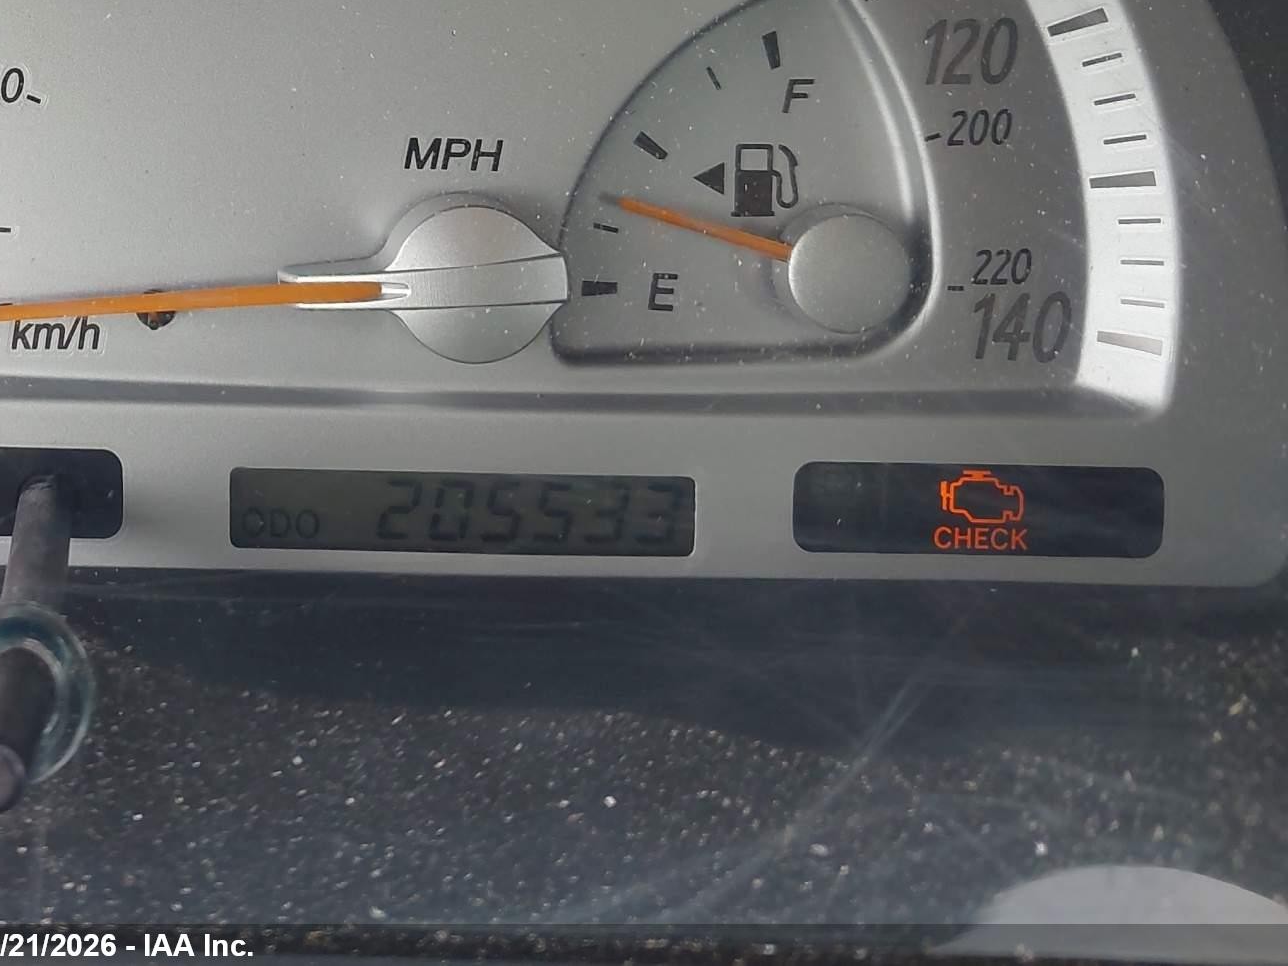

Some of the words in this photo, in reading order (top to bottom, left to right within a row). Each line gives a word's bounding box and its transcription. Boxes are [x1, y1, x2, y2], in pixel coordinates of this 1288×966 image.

[923, 17, 1019, 85] 120
[783, 79, 814, 113] F
[948, 109, 1012, 146] 200
[405, 138, 503, 171] MPH
[972, 248, 1032, 285] 220
[648, 273, 678, 311] E
[10, 316, 99, 350] km/h
[974, 291, 1072, 363] 140
[242, 509, 320, 536] ODO
[376, 481, 682, 542] 205533
[934, 527, 1026, 549] CHECK
